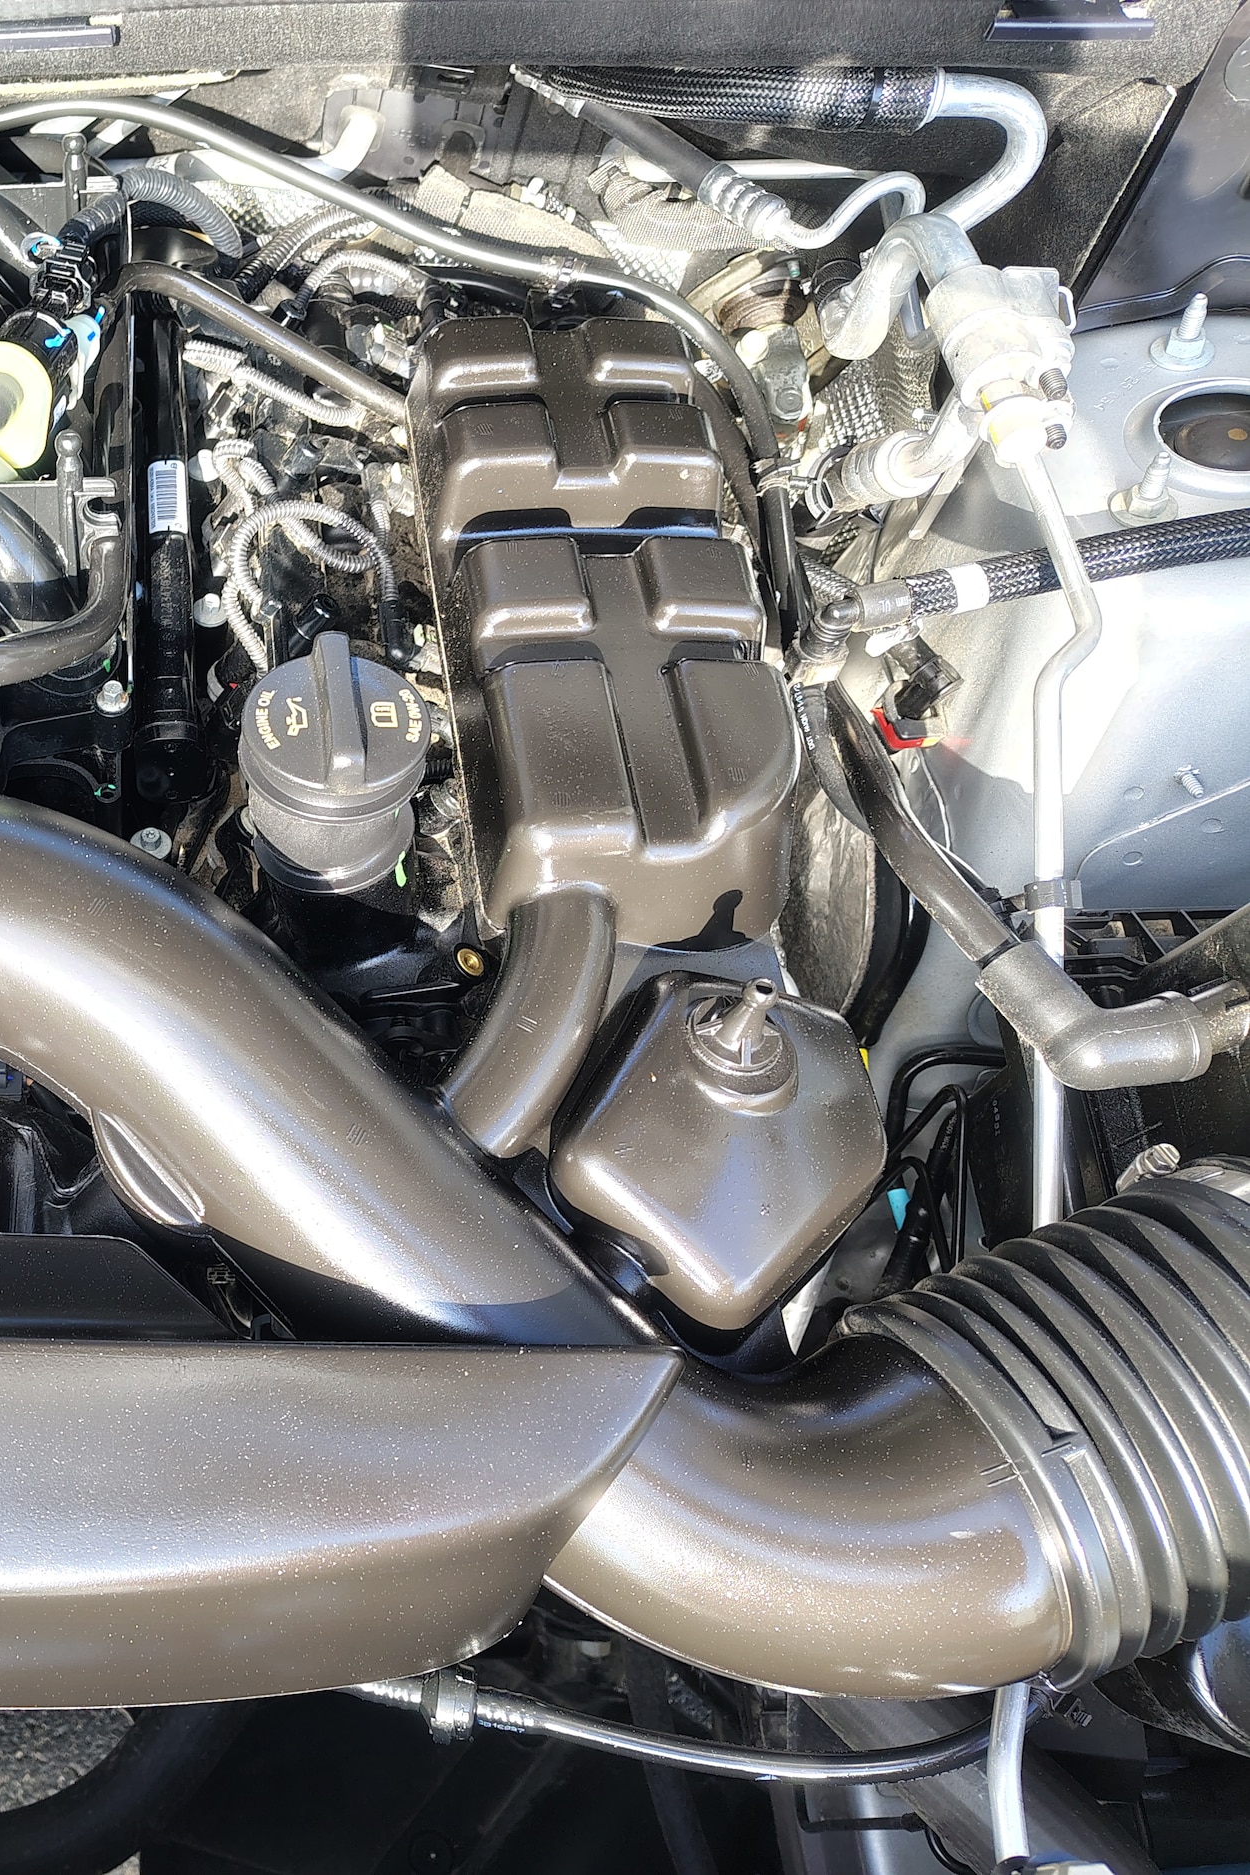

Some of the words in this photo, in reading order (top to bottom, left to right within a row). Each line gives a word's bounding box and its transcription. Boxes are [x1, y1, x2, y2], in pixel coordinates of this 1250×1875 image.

[258, 690, 276, 707] OIL
[398, 689, 421, 719] 0W-20
[255, 708, 281, 750] ENGINE
[406, 719, 423, 743] SAE
